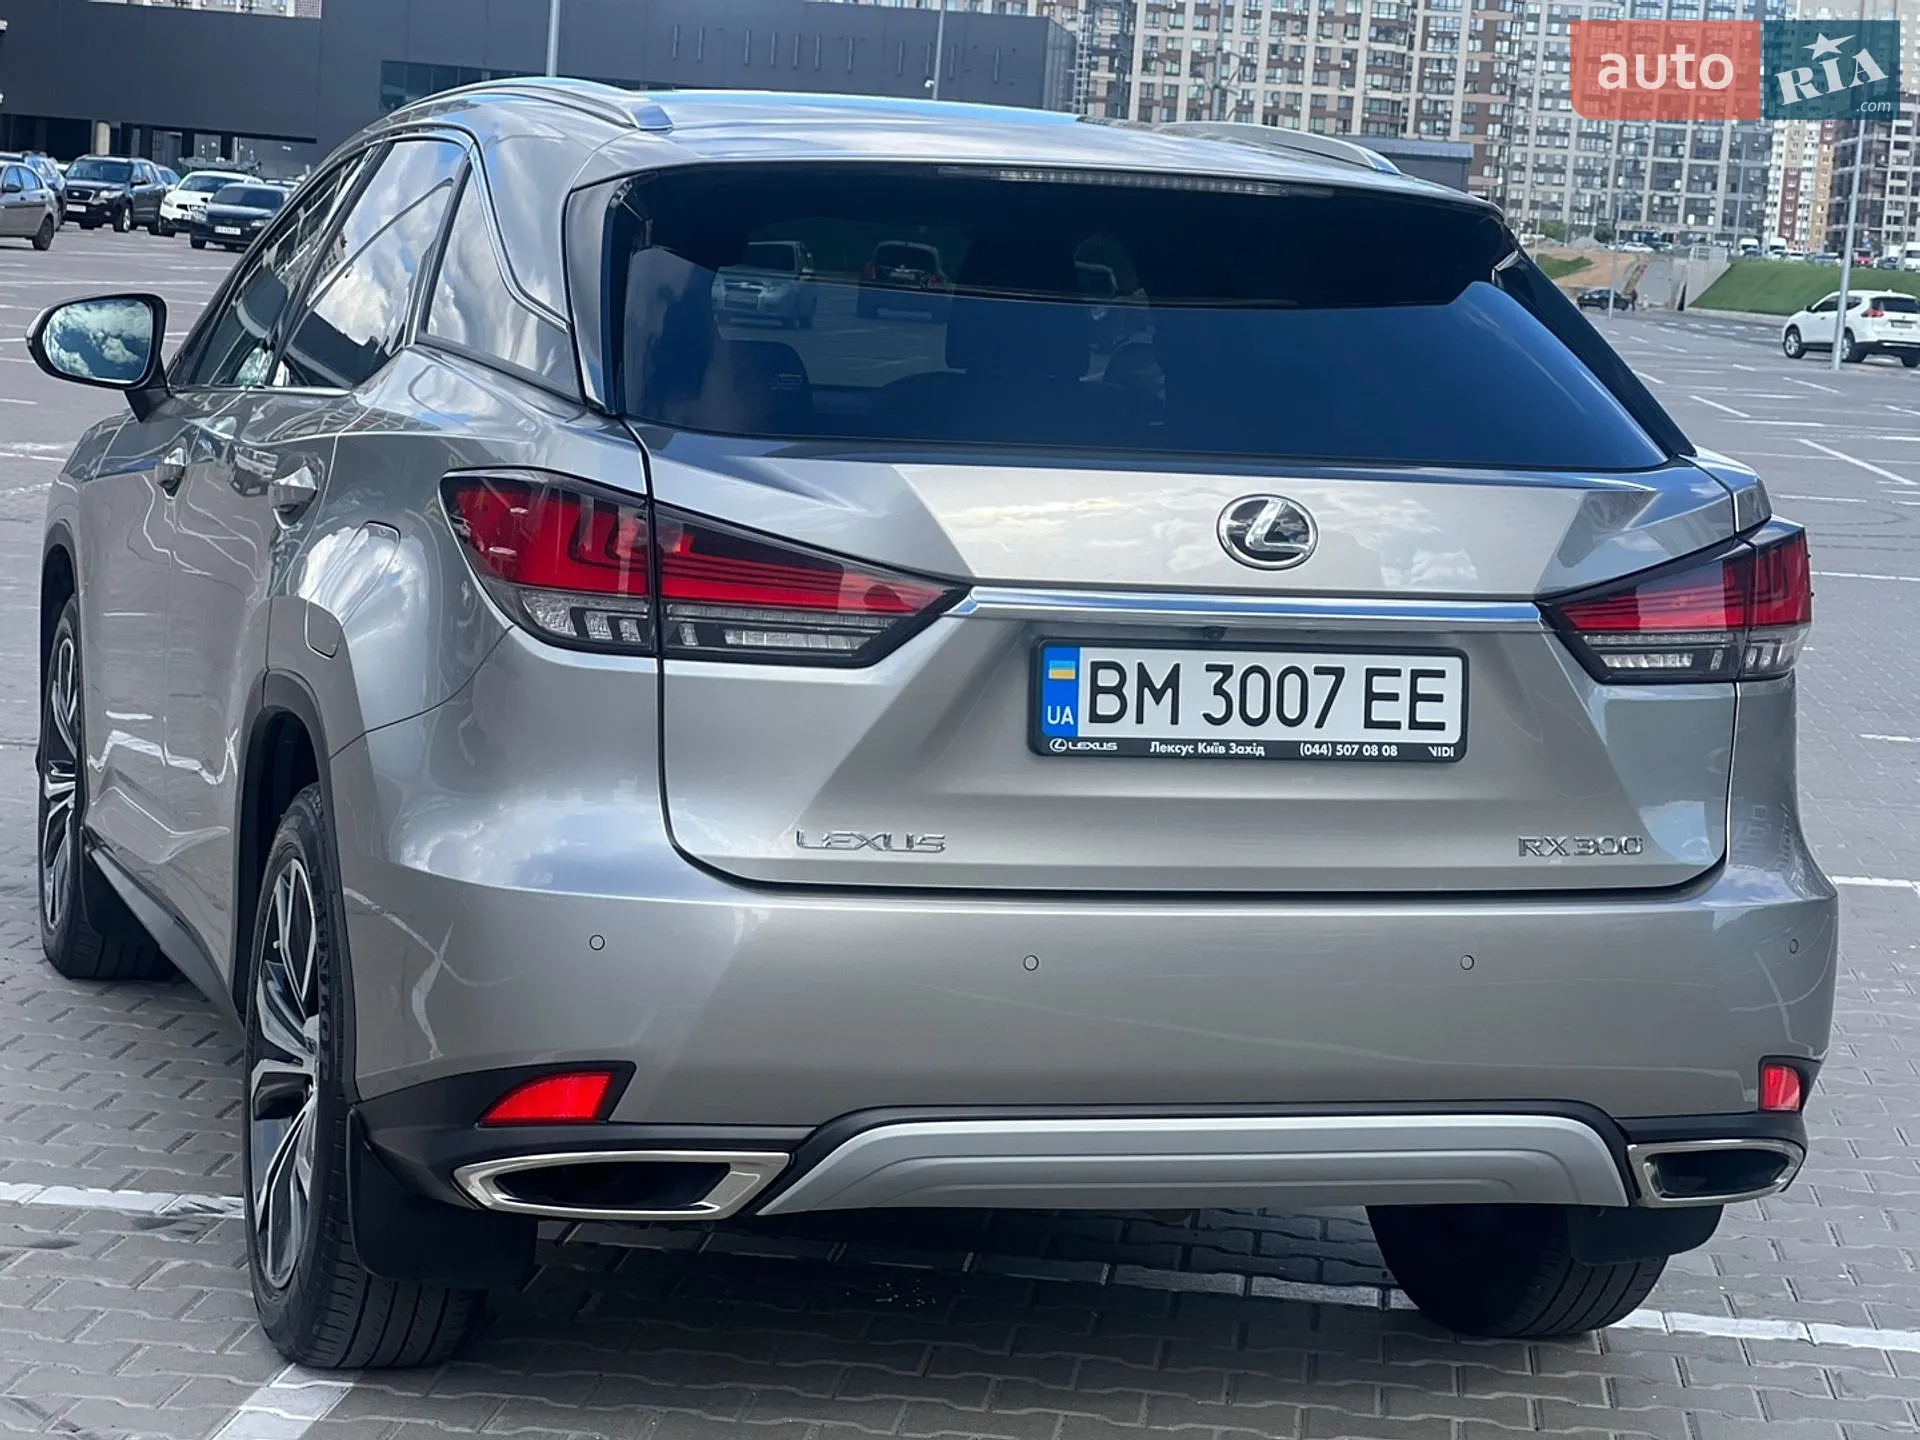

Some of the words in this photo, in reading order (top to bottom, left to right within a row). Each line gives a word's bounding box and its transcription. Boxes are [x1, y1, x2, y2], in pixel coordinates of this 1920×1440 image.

[1087, 659, 1182, 726] BM
[1200, 663, 1346, 730] 3007
[1363, 666, 1447, 732] EE
[1046, 705, 1075, 726] UA
[1068, 741, 1118, 751] LEXUS
[1149, 741, 1195, 757] Лексус
[1198, 741, 1226, 755] Київ
[1229, 742, 1266, 757] Захід
[1300, 742, 1333, 758] (044)
[1336, 744, 1360, 757] 507
[1362, 744, 1380, 757] 08
[1382, 744, 1399, 757] 08
[1428, 746, 1455, 758] VIDI
[796, 828, 948, 854] LEXUS
[1518, 835, 1571, 857] RX
[1573, 835, 1644, 857] 300
